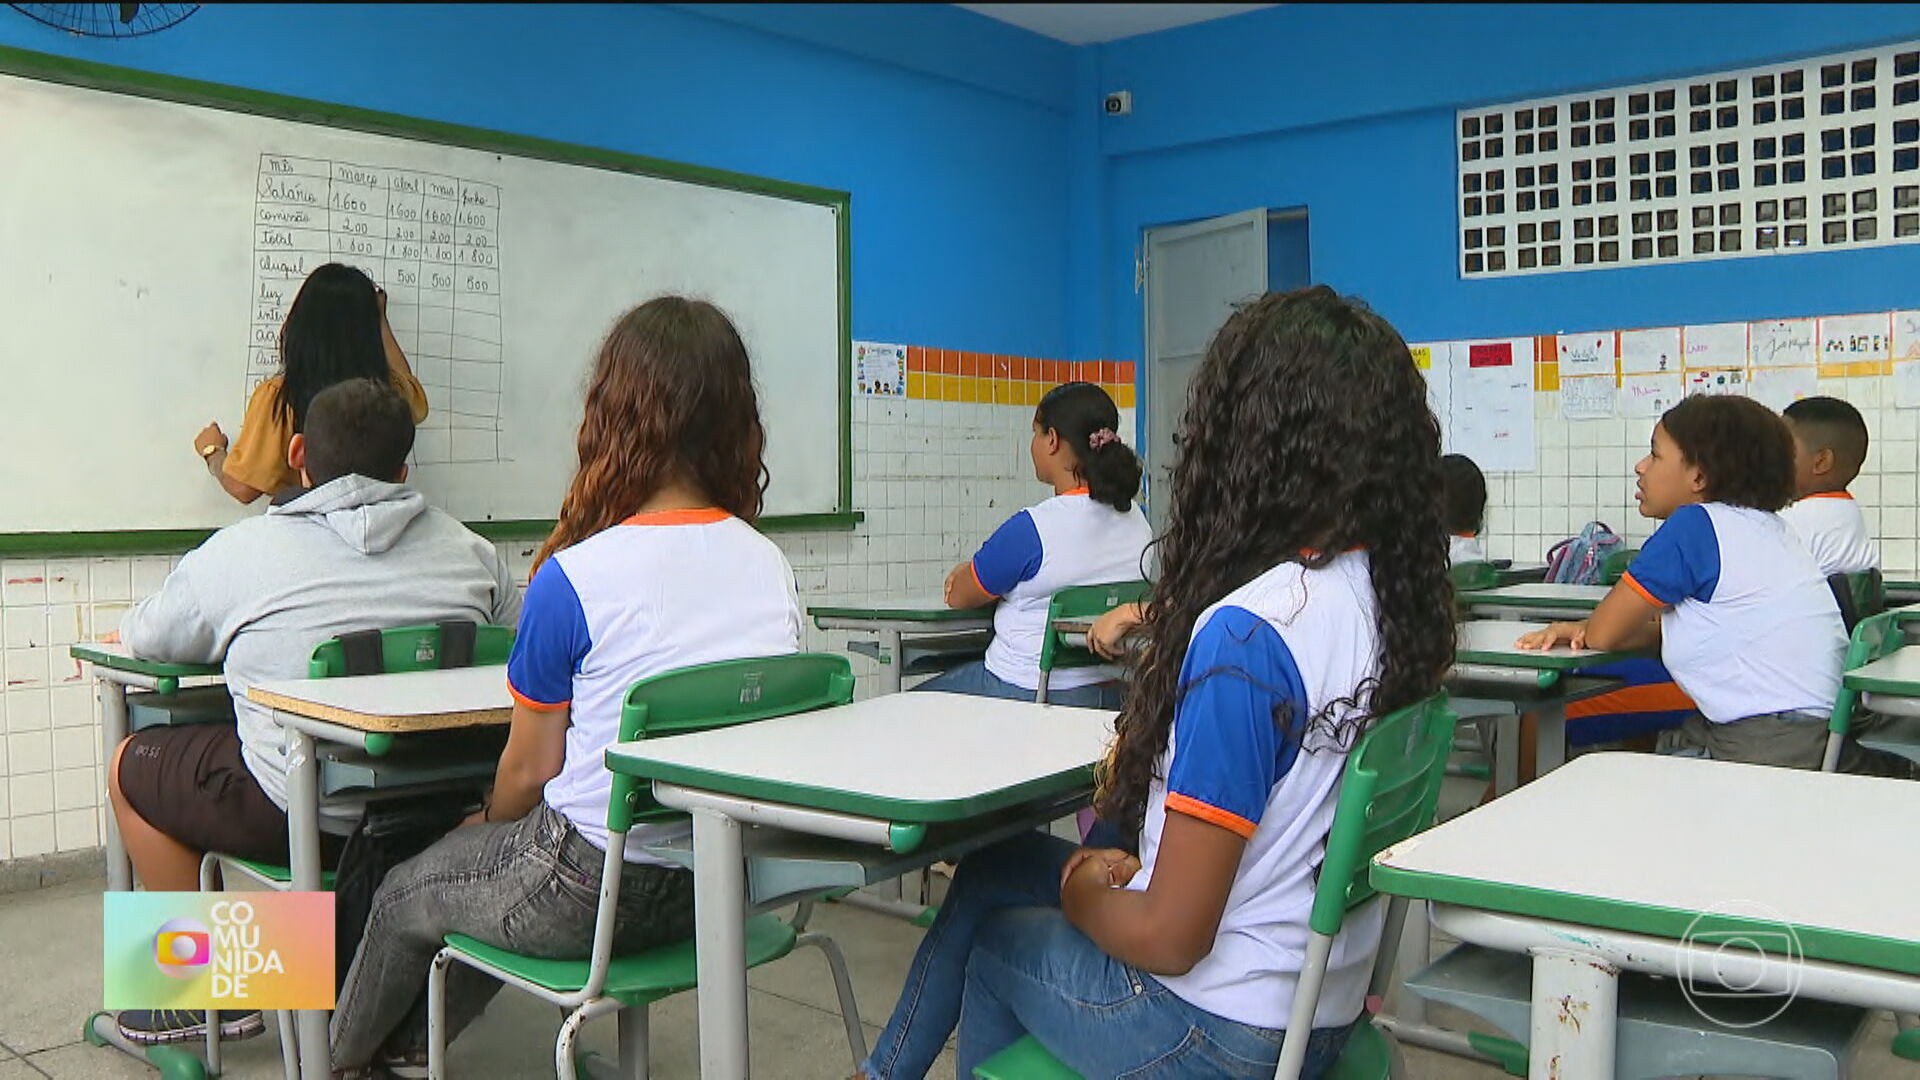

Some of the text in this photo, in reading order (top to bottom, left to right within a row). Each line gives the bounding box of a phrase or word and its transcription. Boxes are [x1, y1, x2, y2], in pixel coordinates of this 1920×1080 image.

[397, 269, 417, 284] 500
[432, 273, 451, 288] 500
[467, 278, 489, 292] 500
